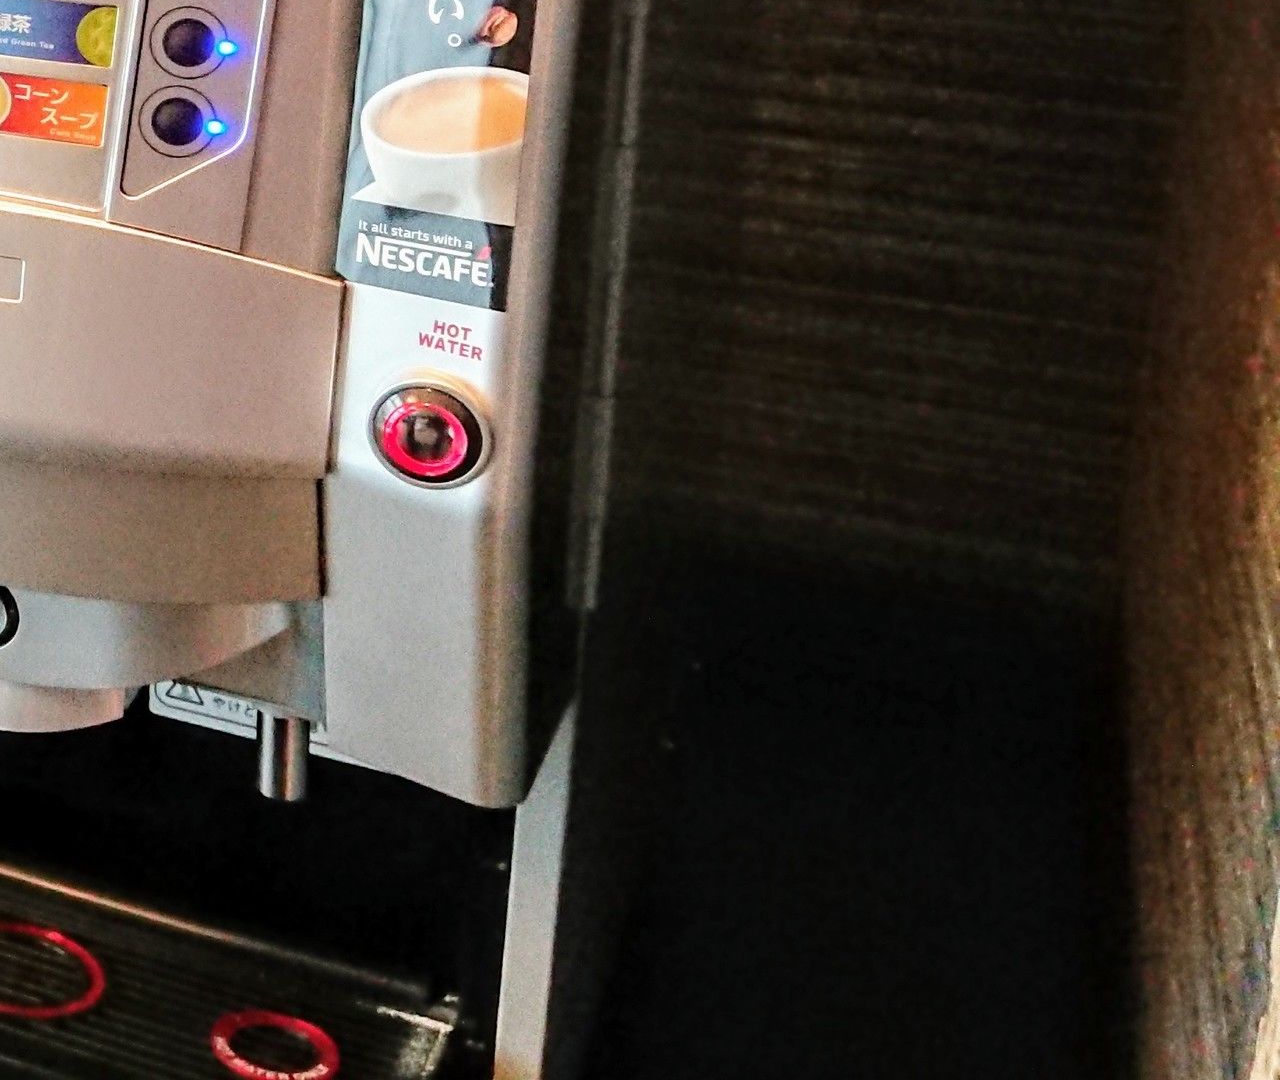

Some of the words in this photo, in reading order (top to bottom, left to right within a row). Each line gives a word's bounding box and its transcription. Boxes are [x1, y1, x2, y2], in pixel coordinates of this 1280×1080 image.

[14, 83, 70, 105] コーン
[358, 219, 369, 231] It
[371, 221, 389, 235] all
[389, 224, 430, 244] starts
[432, 231, 462, 250] with
[463, 239, 473, 250] a
[355, 232, 492, 288] NESCAFÉ
[432, 319, 473, 341] HOT
[417, 331, 483, 361] WATER
